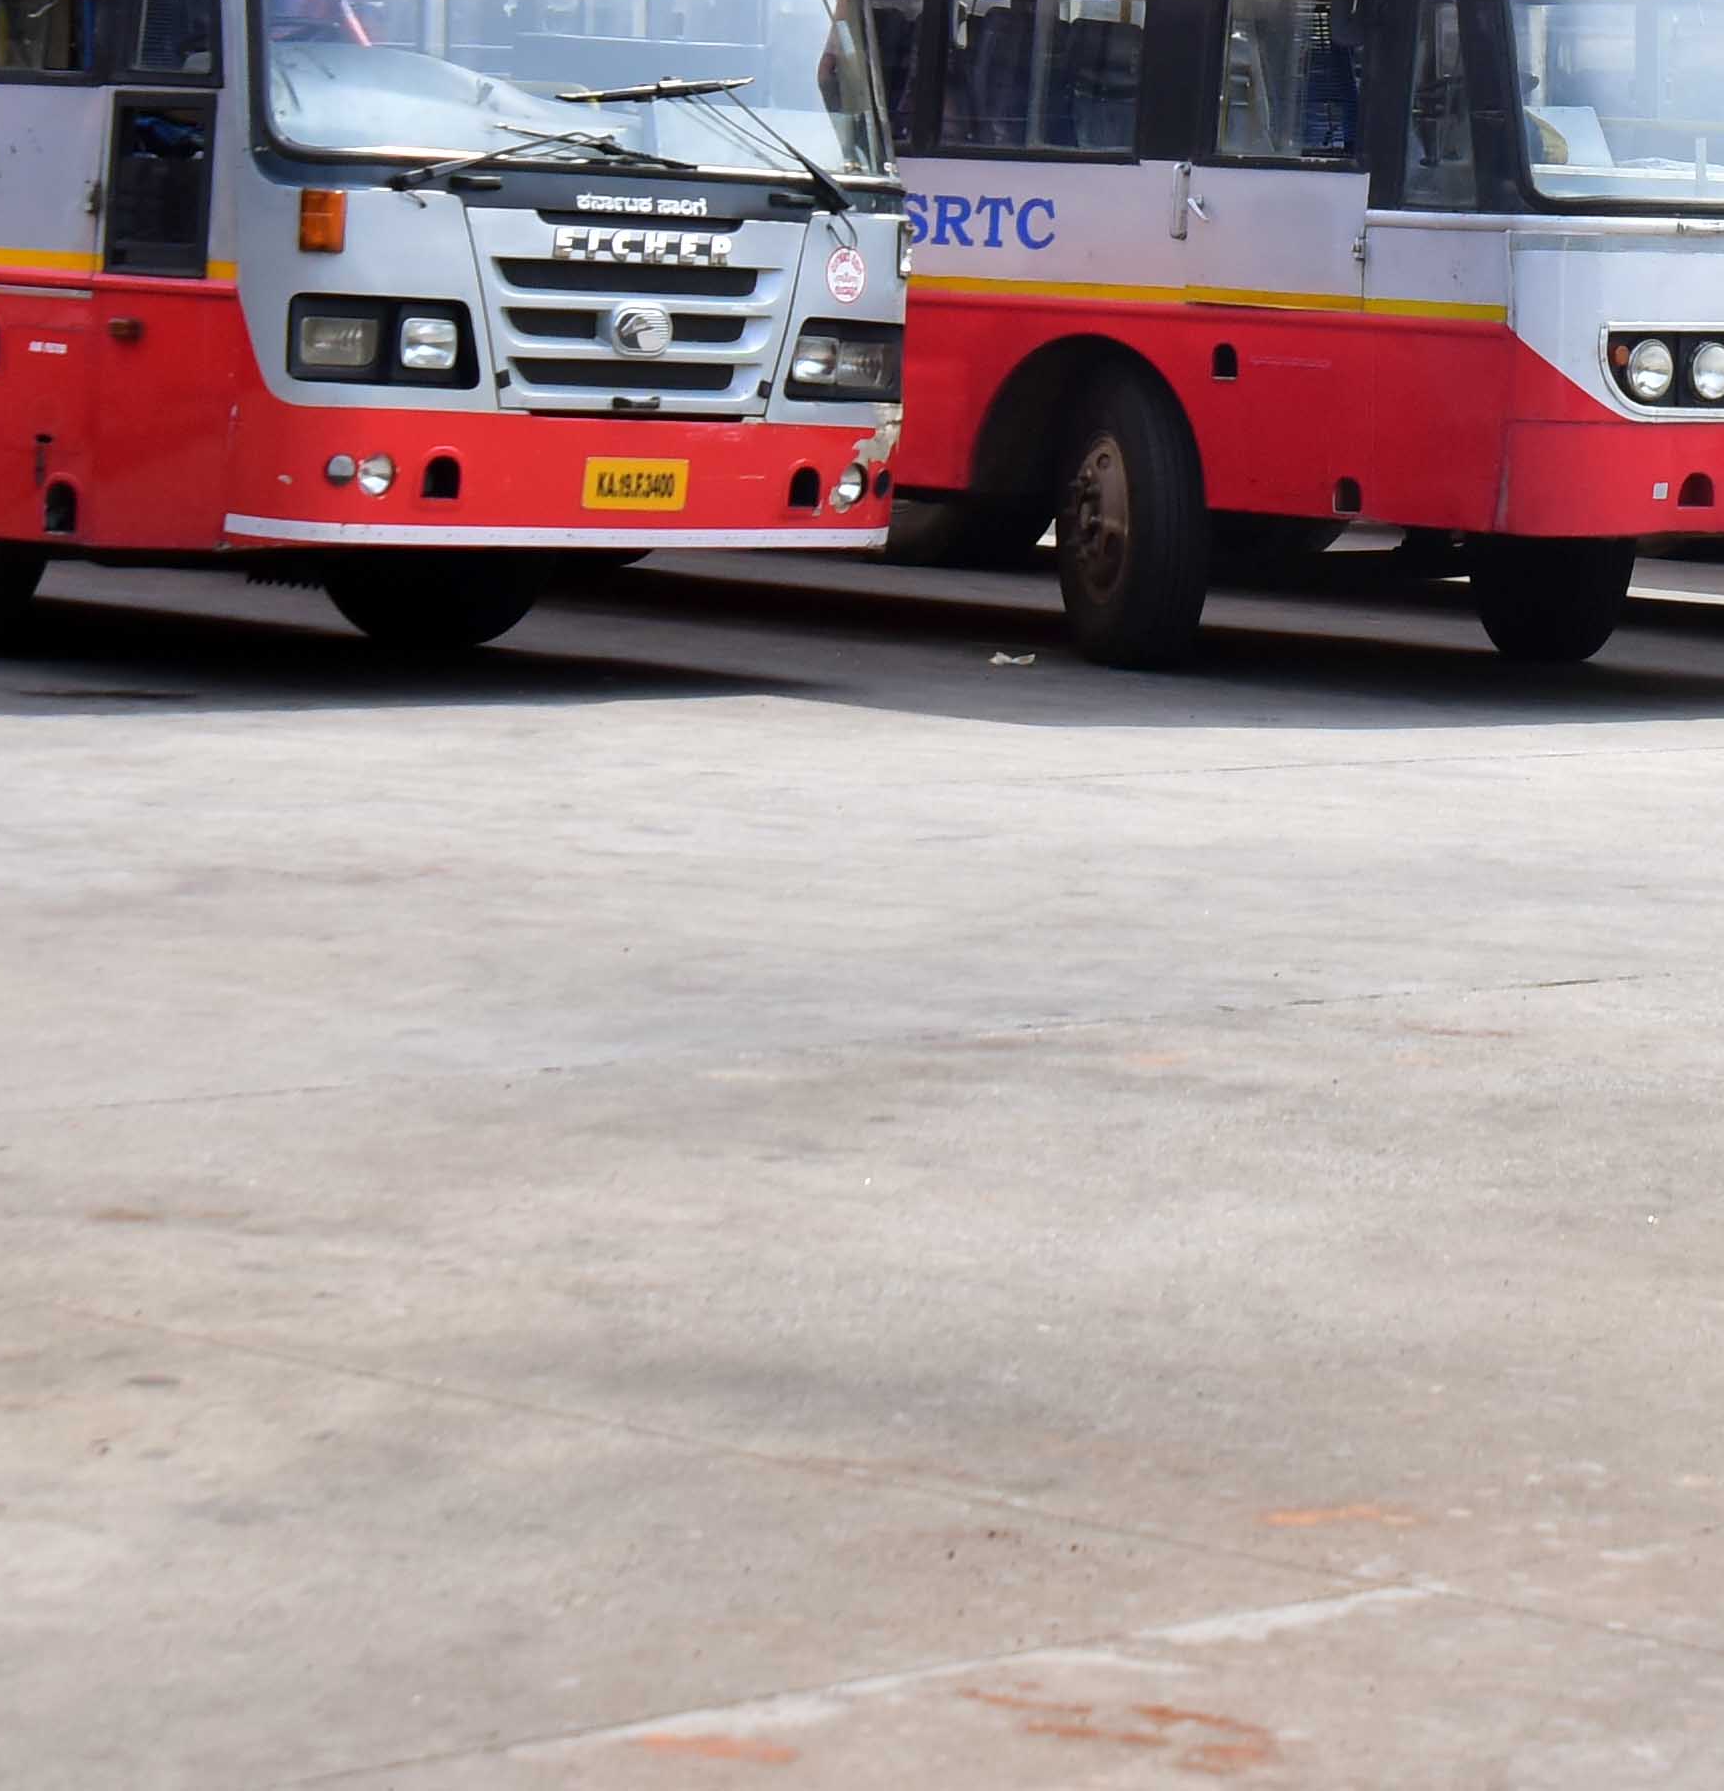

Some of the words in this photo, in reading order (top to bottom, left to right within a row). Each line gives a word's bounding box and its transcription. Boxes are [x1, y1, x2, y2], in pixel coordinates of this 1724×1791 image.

[575, 191, 653, 213] ಕರ್ನಾಟಕ
[656, 196, 708, 217] ಸಾರಿಗೆ
[554, 227, 733, 266] EICHER
